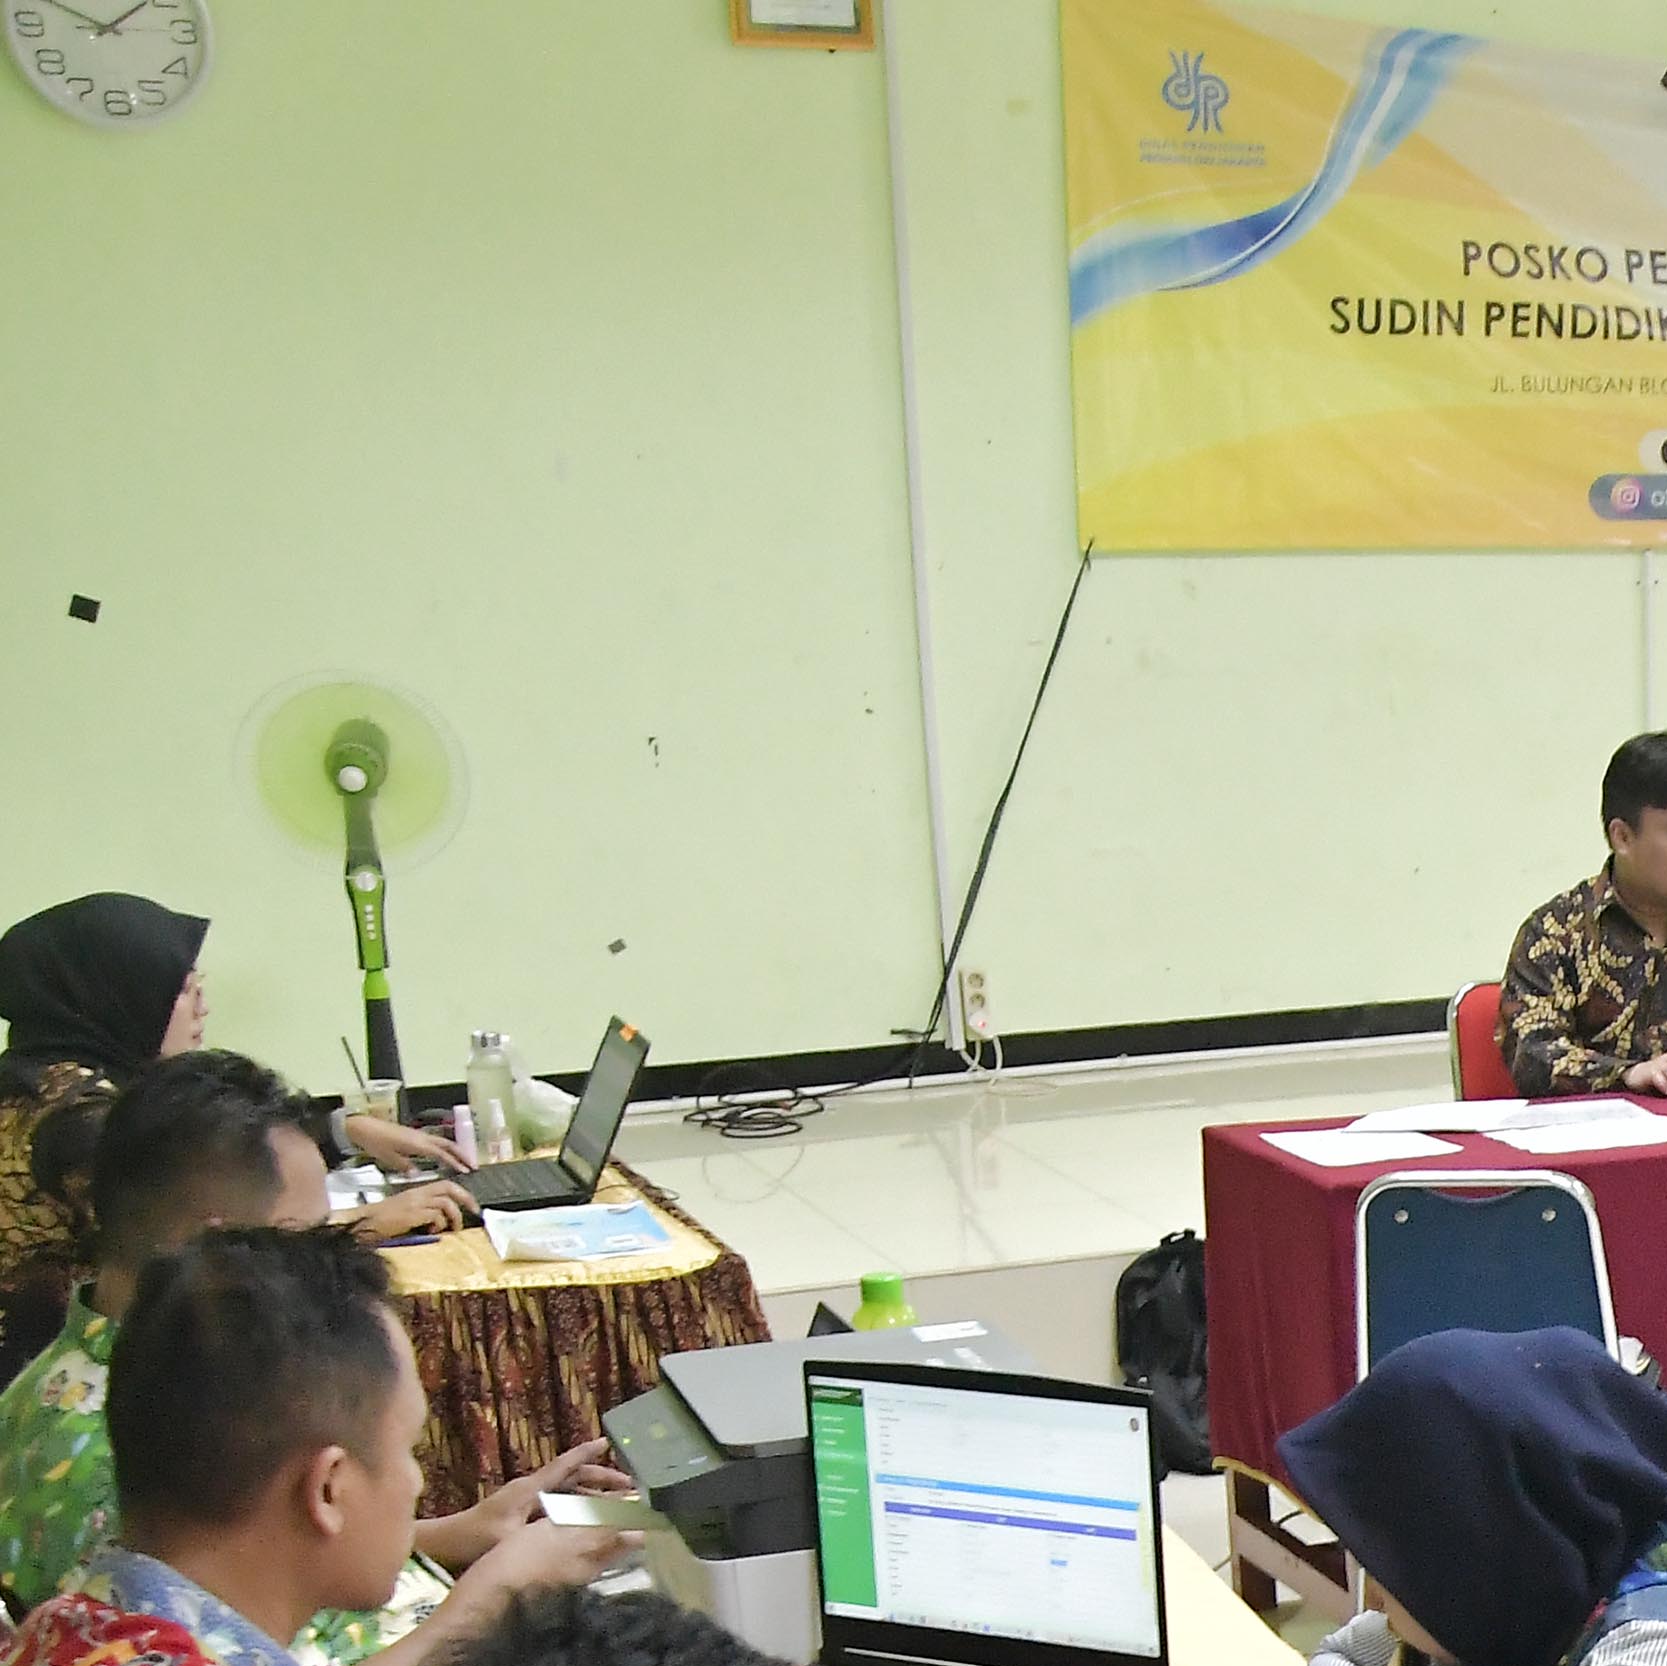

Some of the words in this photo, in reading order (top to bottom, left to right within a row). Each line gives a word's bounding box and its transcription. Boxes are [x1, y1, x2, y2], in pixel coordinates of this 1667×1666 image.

[14, 11, 44, 37] 9
[170, 19, 197, 45] 3
[36, 49, 66, 75] 8
[162, 56, 190, 80] 4
[66, 77, 94, 102] 7
[138, 80, 167, 105] 5
[104, 90, 132, 116] 6
[1461, 240, 1608, 283] POSKO
[1329, 295, 1465, 337] SUDIN
[1489, 375, 1514, 394] JL.
[1520, 374, 1633, 395] BULUNGAN
